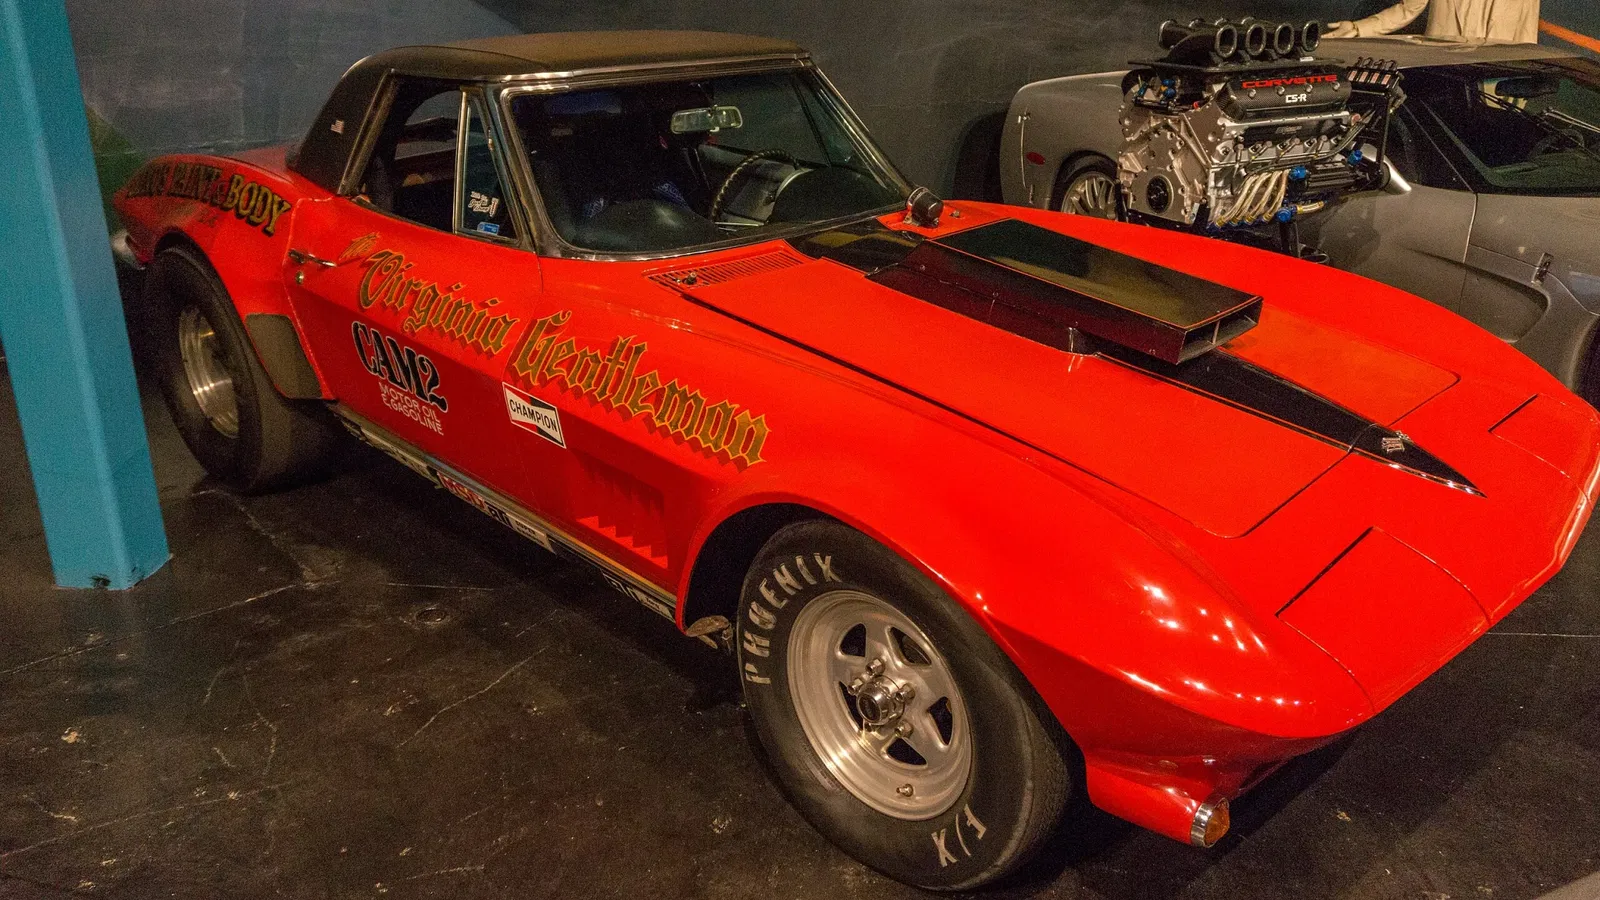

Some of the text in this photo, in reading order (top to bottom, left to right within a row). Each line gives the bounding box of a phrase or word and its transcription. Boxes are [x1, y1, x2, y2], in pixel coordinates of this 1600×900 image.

[1242, 74, 1338, 89] CORVETTE
[225, 173, 292, 237] BODY
[351, 320, 449, 413] CAM2
[359, 249, 772, 467] Virginia Gentleman
[378, 381, 441, 424] MOTOR OIL
[509, 398, 558, 433] CHAMPION
[743, 552, 843, 685] PHOENIX
[930, 803, 987, 868] F/X
